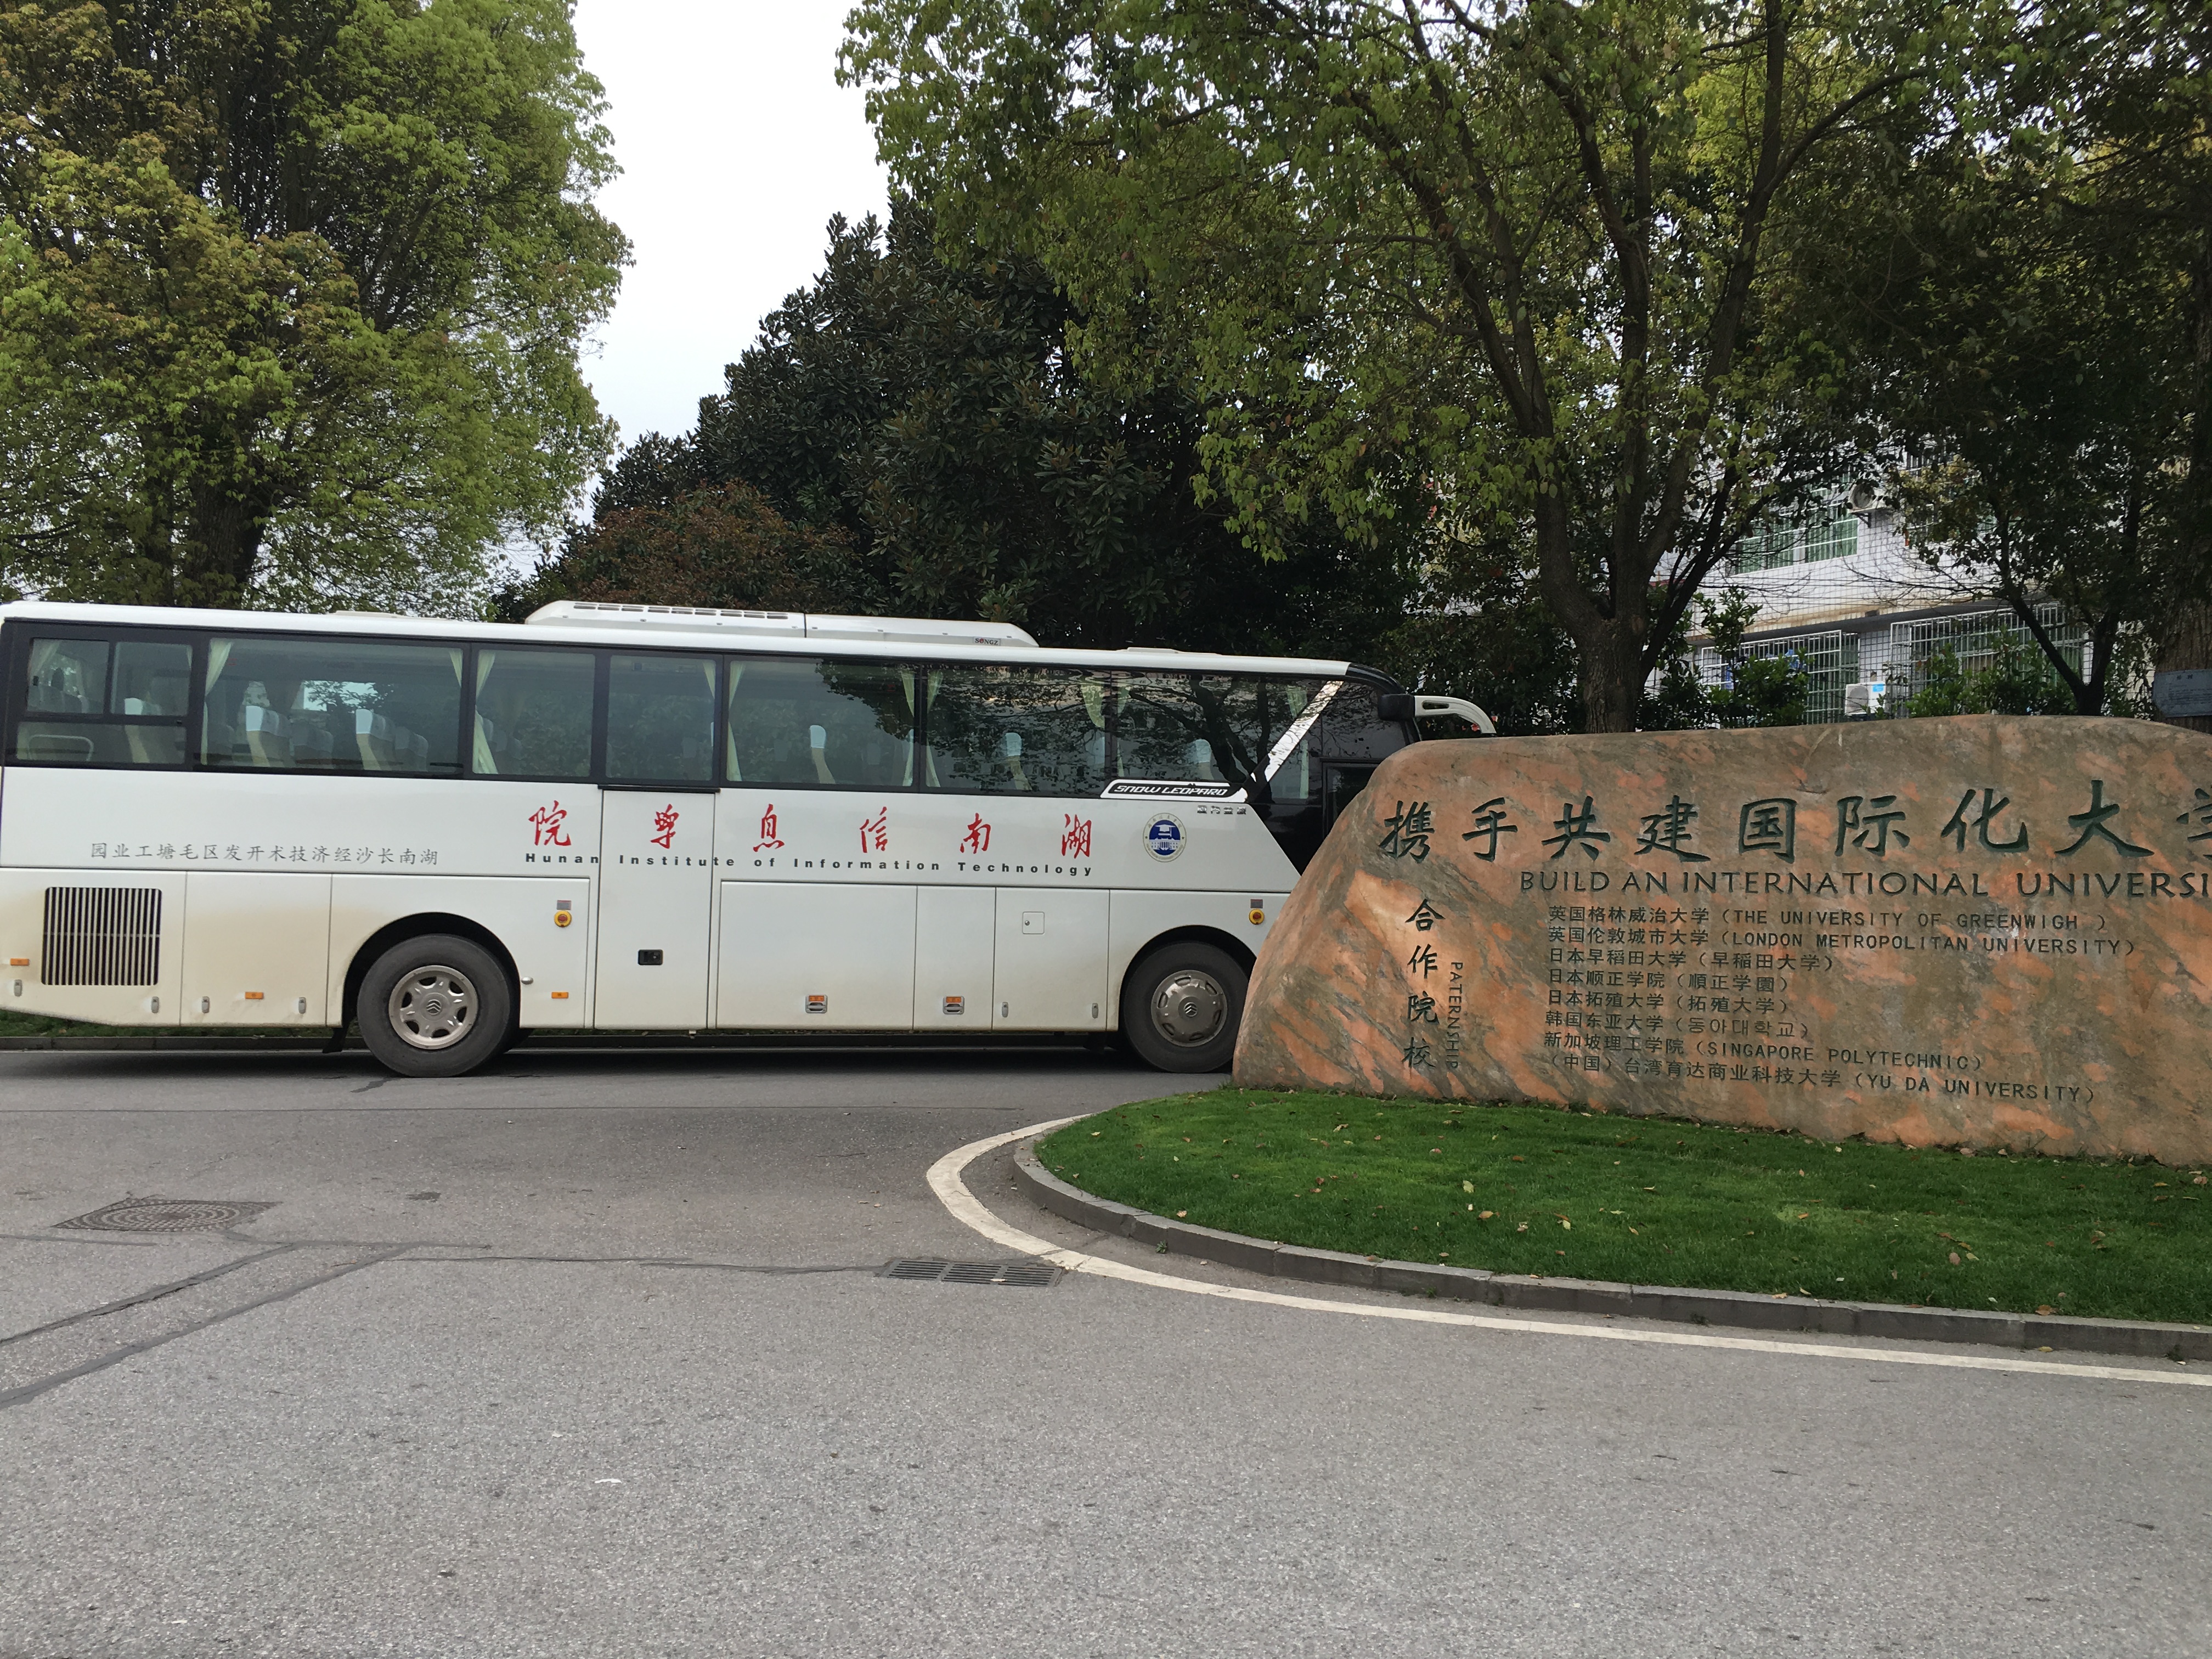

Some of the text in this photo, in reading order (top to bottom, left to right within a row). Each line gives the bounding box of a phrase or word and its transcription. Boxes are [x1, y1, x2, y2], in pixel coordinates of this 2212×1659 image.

[1114, 785, 1228, 795] SNOW LEOPARD
[526, 853, 1091, 876] Hunan Institute of Information Technology
[1521, 871, 1610, 893] BUILD
[1621, 872, 1668, 894] AN
[1683, 872, 1989, 896] INTERNATIONAL
[1549, 905, 1709, 924] 英国格林威治大学
[1781, 911, 1903, 927] UNIVERSITY
[1918, 913, 1942, 927] OF
[1548, 926, 1708, 946] 英国伦敦城市大学
[1816, 934, 1967, 951] METROPOLITAN
[1401, 898, 1446, 1071] 合作院校
[1444, 962, 1464, 1069] PATERNSHIP
[1544, 1031, 1684, 1054] 新加坡理工学院
[1905, 1076, 1930, 1092] DA
